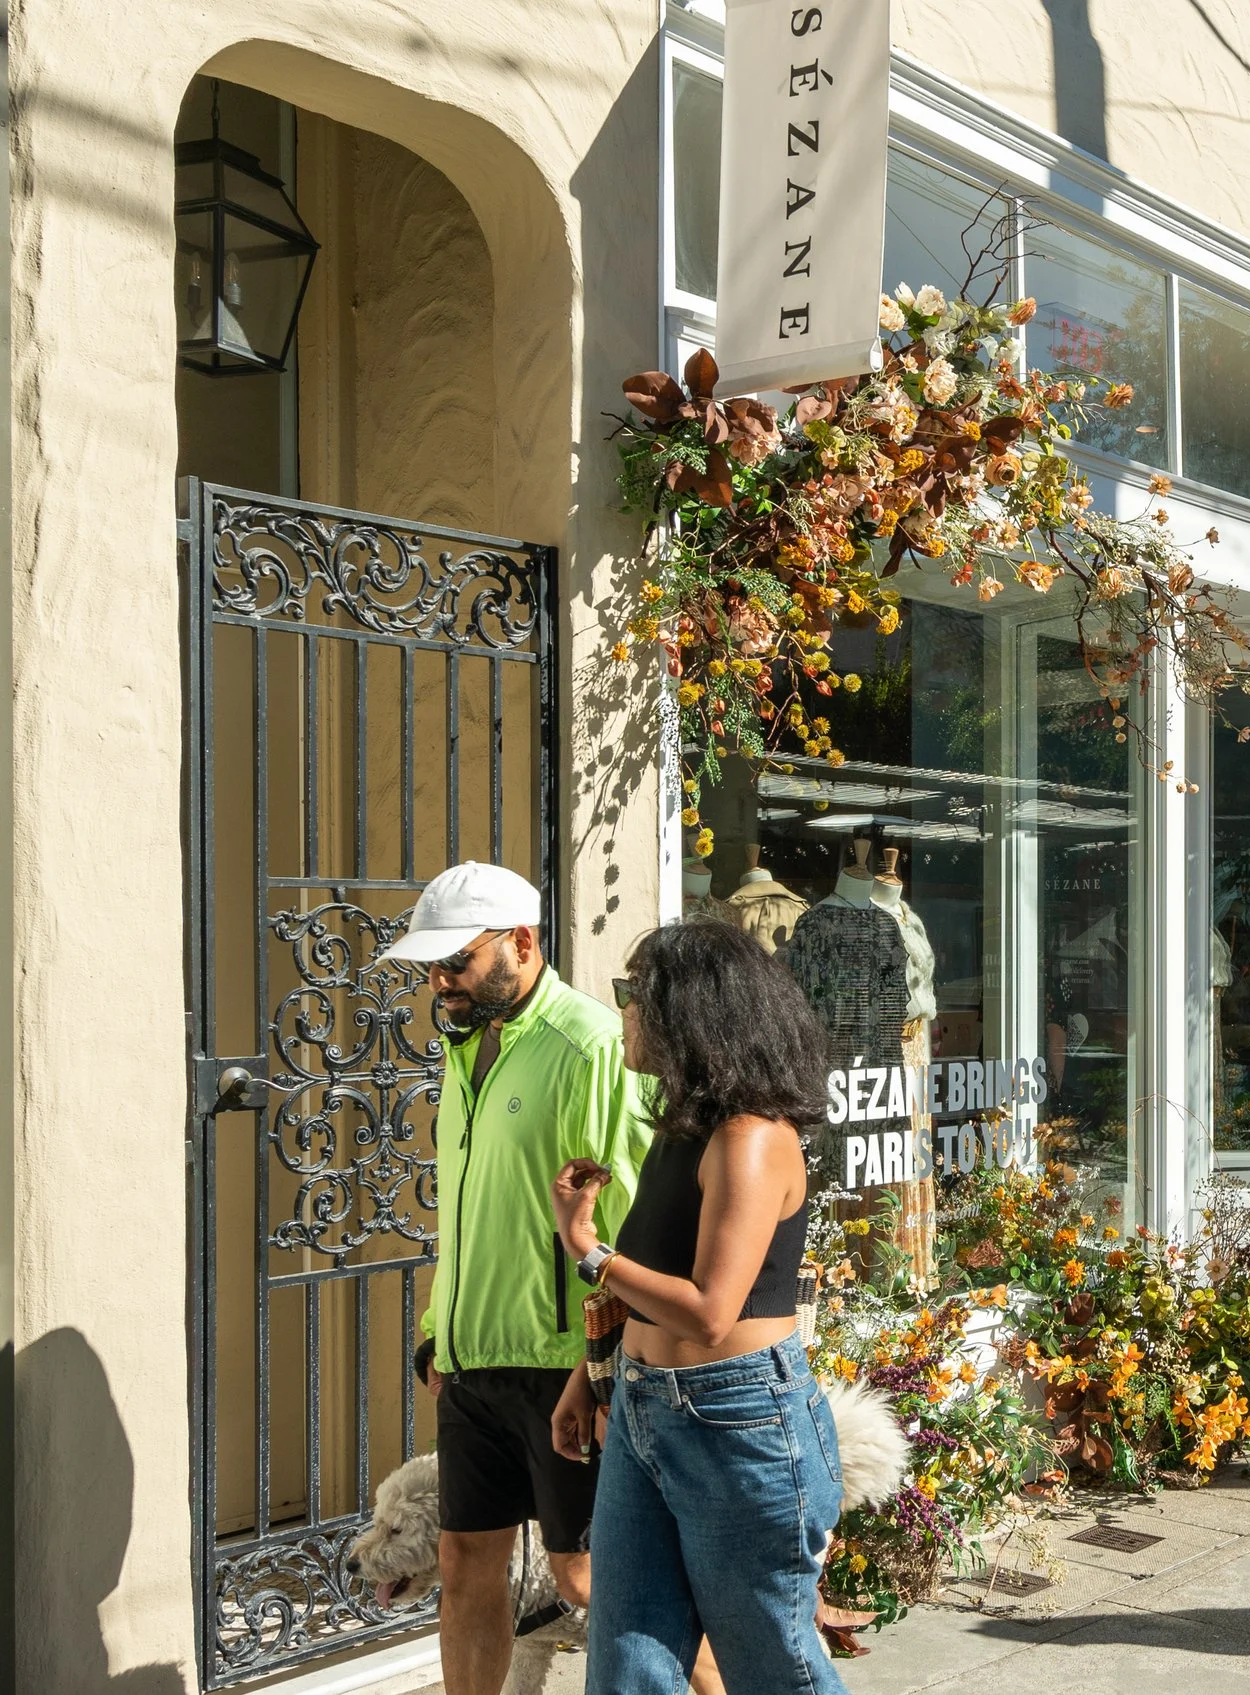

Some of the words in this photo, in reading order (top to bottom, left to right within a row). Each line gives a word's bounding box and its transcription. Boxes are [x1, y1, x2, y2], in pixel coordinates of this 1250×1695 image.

[778, 7, 833, 340] SÉZANE
[1044, 875, 1101, 891] SÉZANE
[826, 1055, 943, 1125] SÉZANE
[948, 1056, 1048, 1113] BRINGS
[846, 1128, 935, 1190] PARIS
[938, 1123, 977, 1176] TO
[980, 1117, 1032, 1171] YOU
